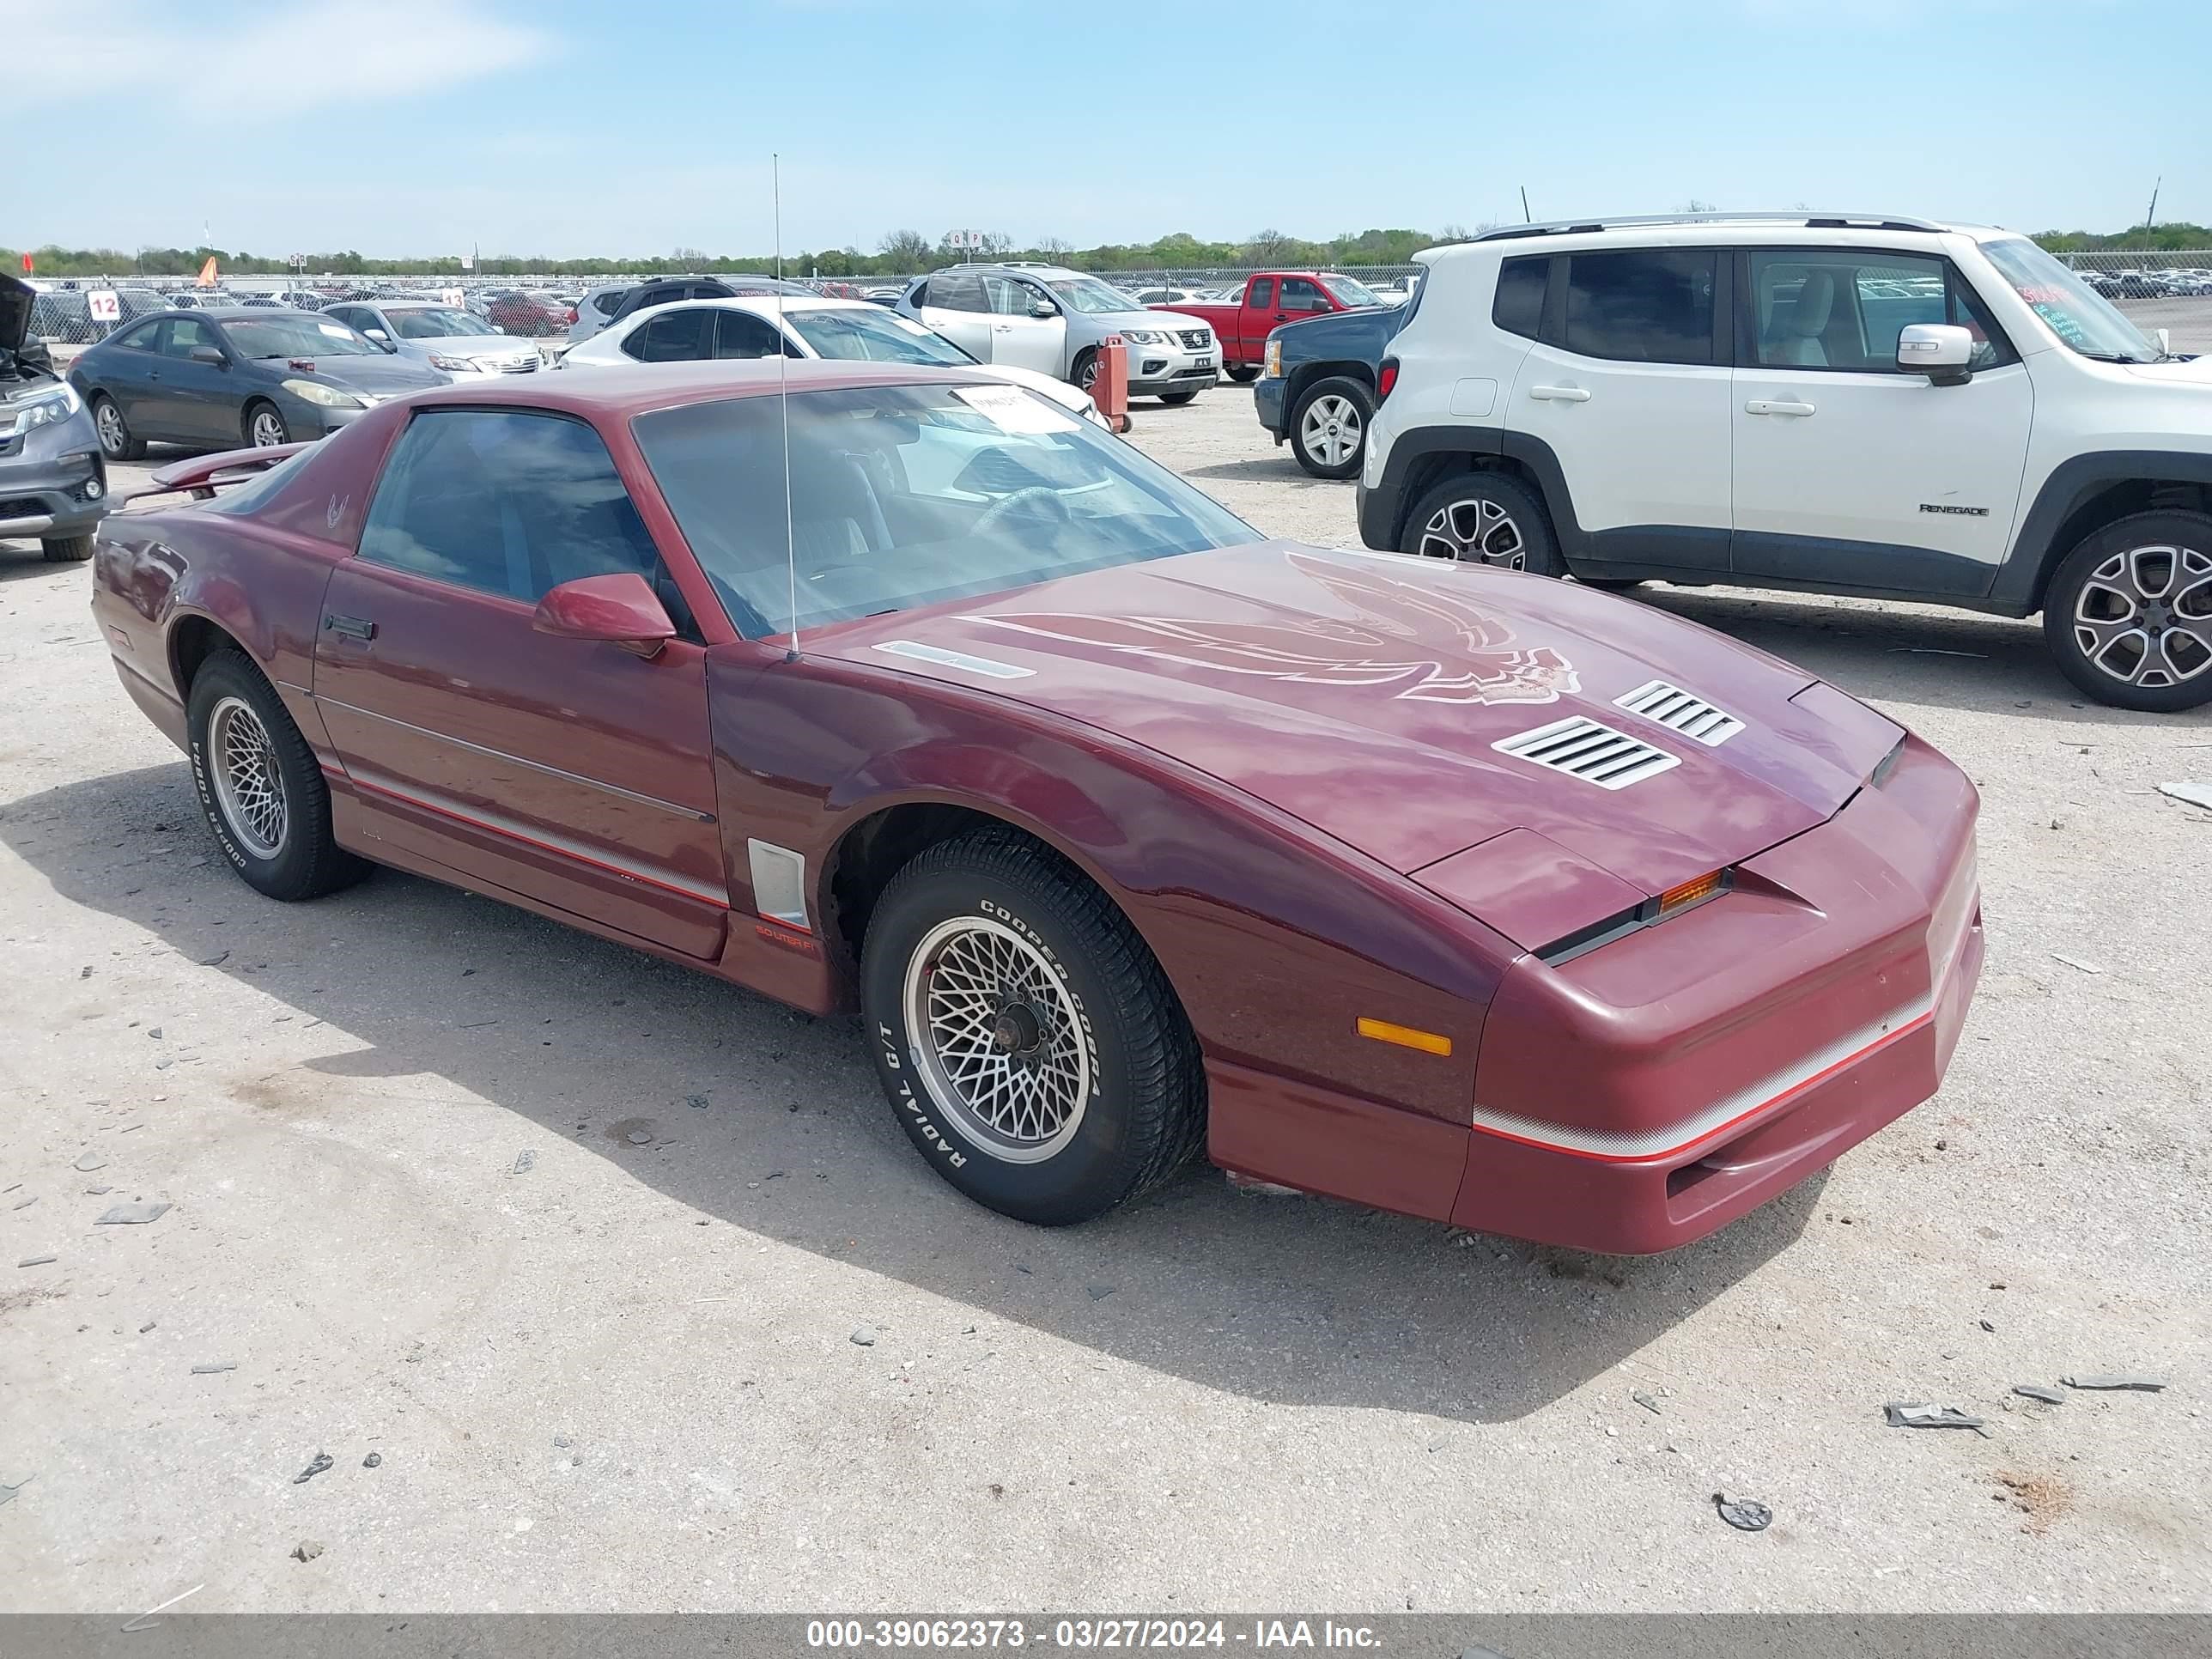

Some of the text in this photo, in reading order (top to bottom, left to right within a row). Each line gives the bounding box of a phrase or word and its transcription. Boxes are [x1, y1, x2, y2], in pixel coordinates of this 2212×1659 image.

[93, 298, 118, 313] 12
[445, 295, 463, 307] 13
[1919, 503, 1990, 517] RENEGADE
[192, 742, 246, 867] COOPER COBRA
[981, 899, 1101, 1097] COOPER COBRA
[878, 1020, 968, 1168] RADIAL G/T
